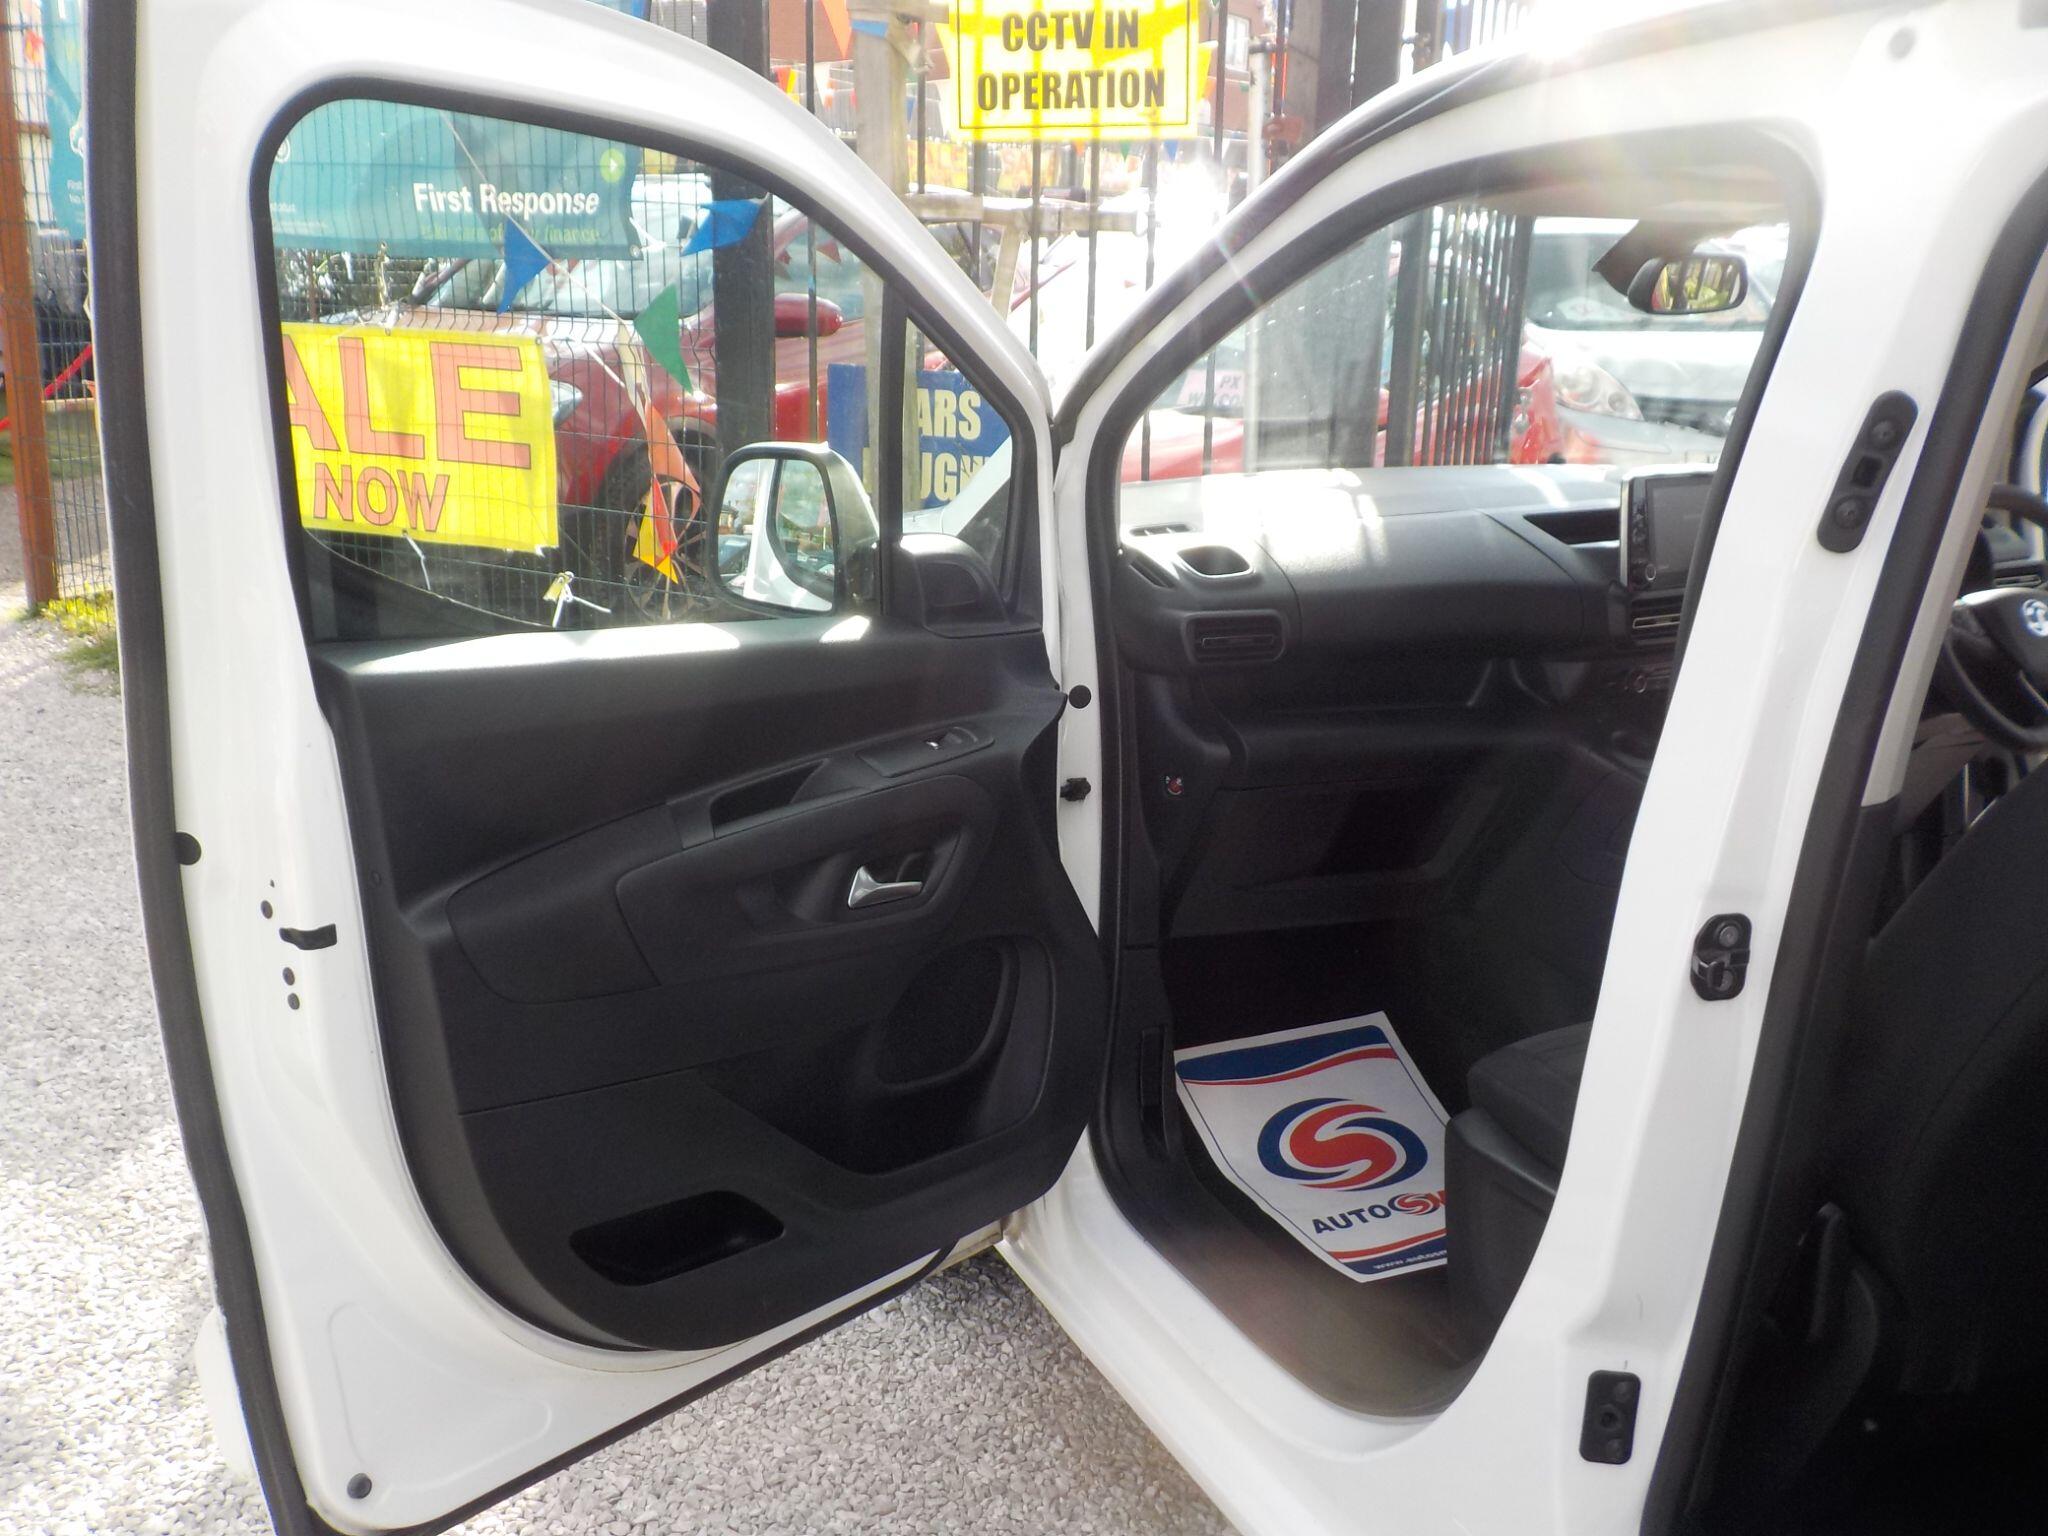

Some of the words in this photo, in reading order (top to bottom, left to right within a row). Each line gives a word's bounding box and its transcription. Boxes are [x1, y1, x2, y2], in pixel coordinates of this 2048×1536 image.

[1002, 10, 1095, 52] CCTV
[1104, 8, 1139, 49] IN
[977, 68, 1165, 111] OPERATION
[413, 182, 472, 214] First
[480, 183, 600, 220] Response
[281, 333, 532, 470] ALE
[917, 388, 982, 441] ARS
[313, 462, 450, 532] NOW
